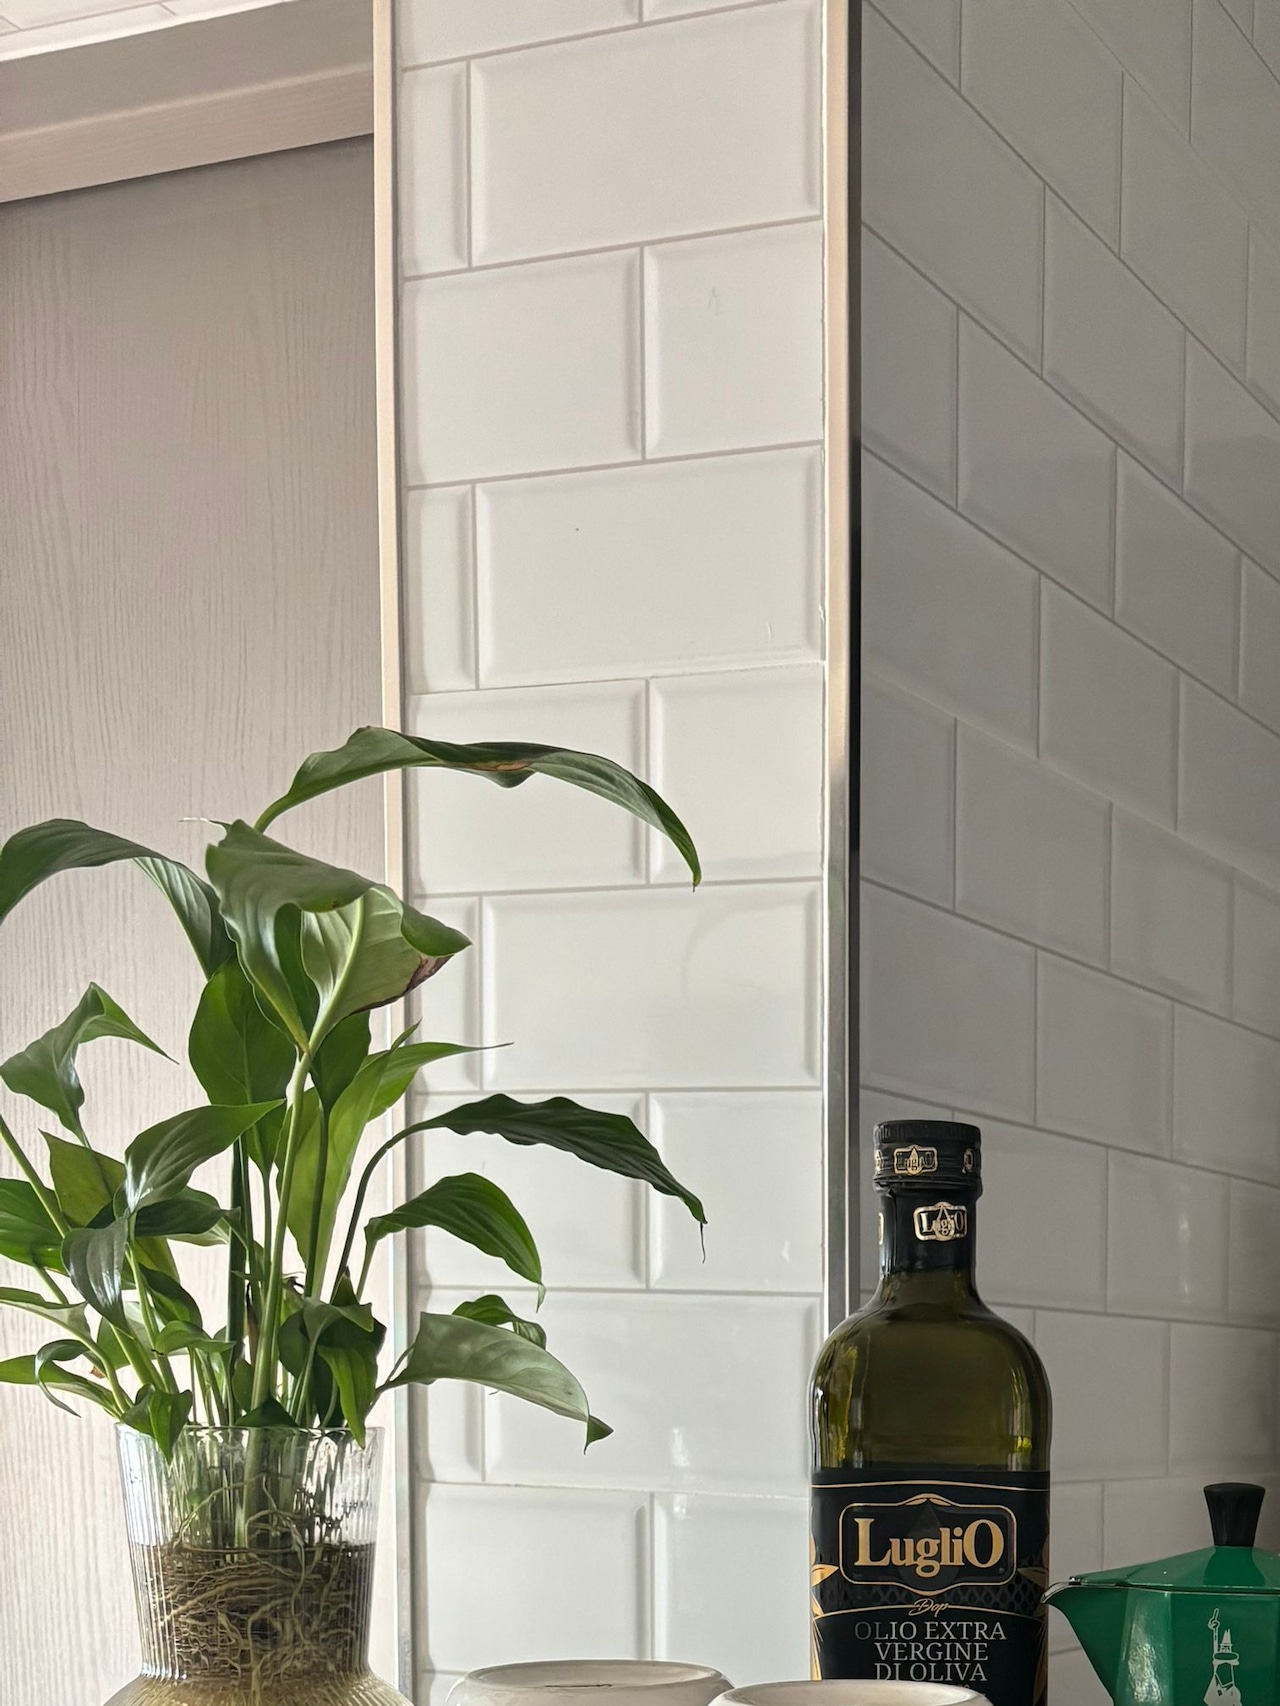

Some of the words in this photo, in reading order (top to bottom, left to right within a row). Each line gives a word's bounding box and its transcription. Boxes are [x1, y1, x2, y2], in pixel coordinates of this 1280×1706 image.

[908, 1598, 949, 1617] Dop
[854, 1621, 917, 1640] OLIO
[924, 1621, 1007, 1640] EXTRA
[874, 1642, 989, 1661] VERGINE
[874, 1663, 902, 1680] DI
[909, 1663, 988, 1682] OLIVA
